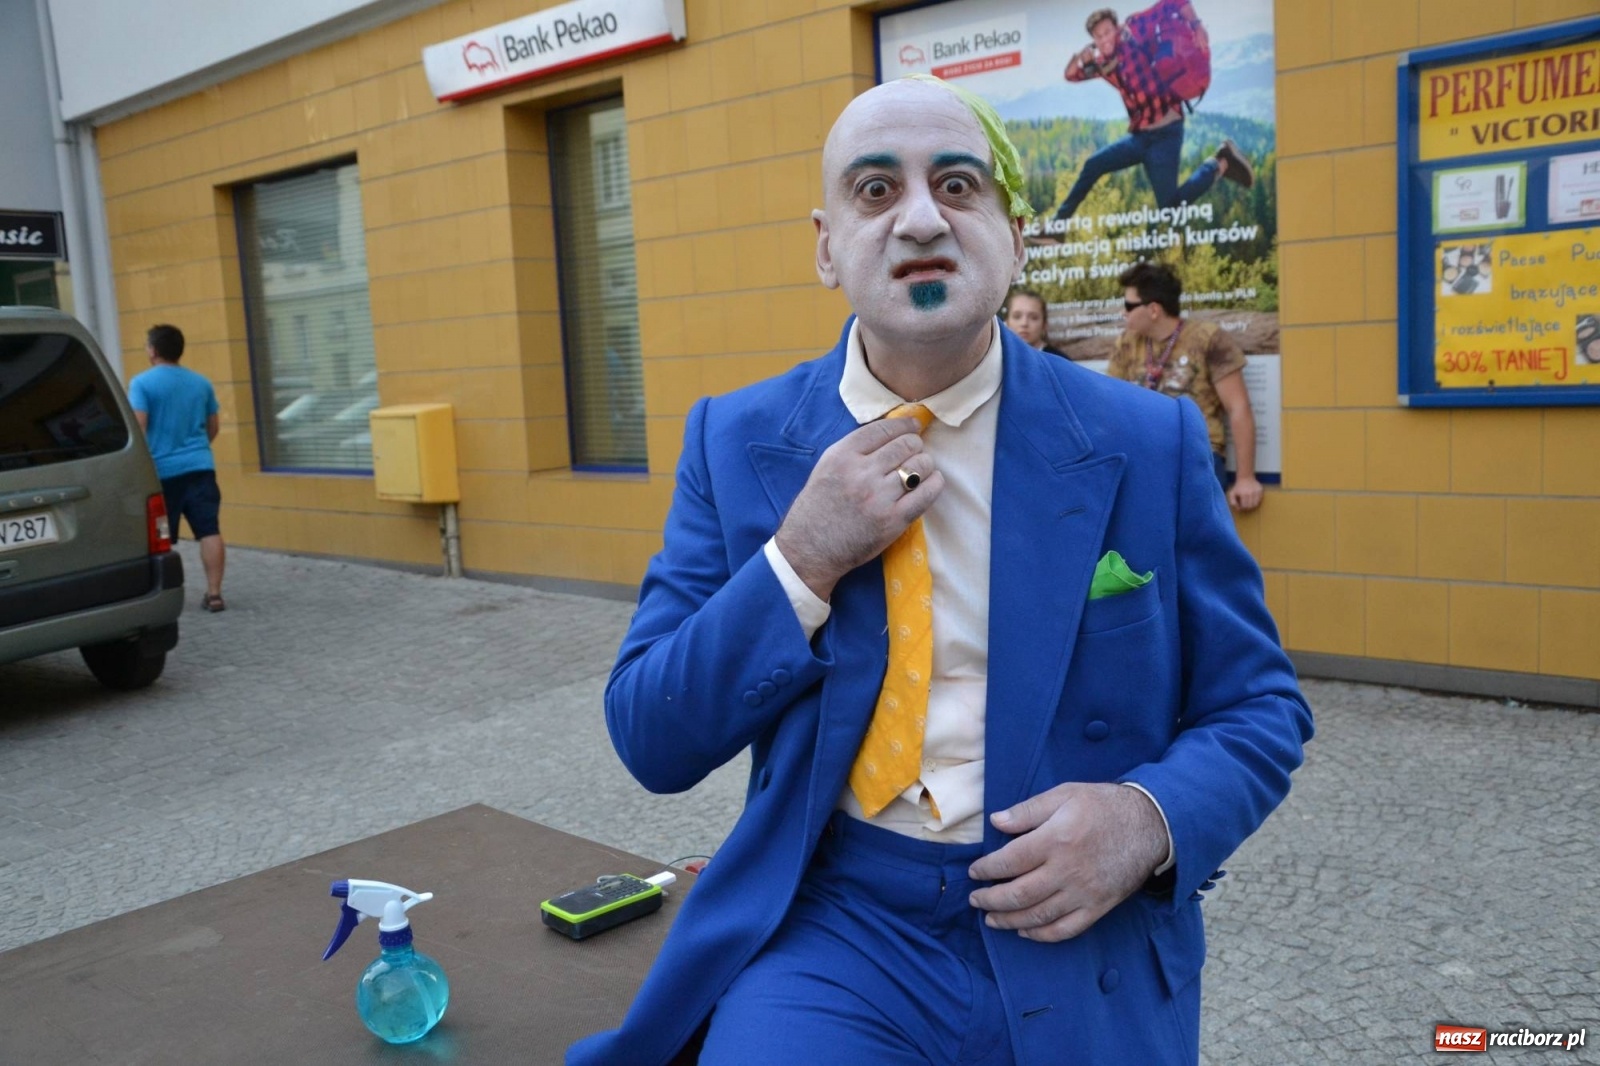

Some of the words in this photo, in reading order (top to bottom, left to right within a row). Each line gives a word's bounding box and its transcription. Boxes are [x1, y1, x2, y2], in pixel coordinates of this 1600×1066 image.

[503, 26, 553, 64] Bank
[554, 12, 618, 49] Pekao
[933, 36, 971, 60] Bank
[974, 29, 1022, 51] Pekao
[1429, 48, 1600, 119] PERFUME
[1044, 213, 1093, 235] kartą
[1098, 200, 1214, 227] rewolucyjną
[1026, 235, 1111, 259] warancją
[1116, 227, 1181, 252] niskich
[1185, 221, 1259, 246] kursów
[1031, 264, 1086, 288] całym
[1510, 284, 1598, 308] brązujące
[1443, 350, 1488, 375] 30%
[1491, 347, 1568, 381] TANIEJ
